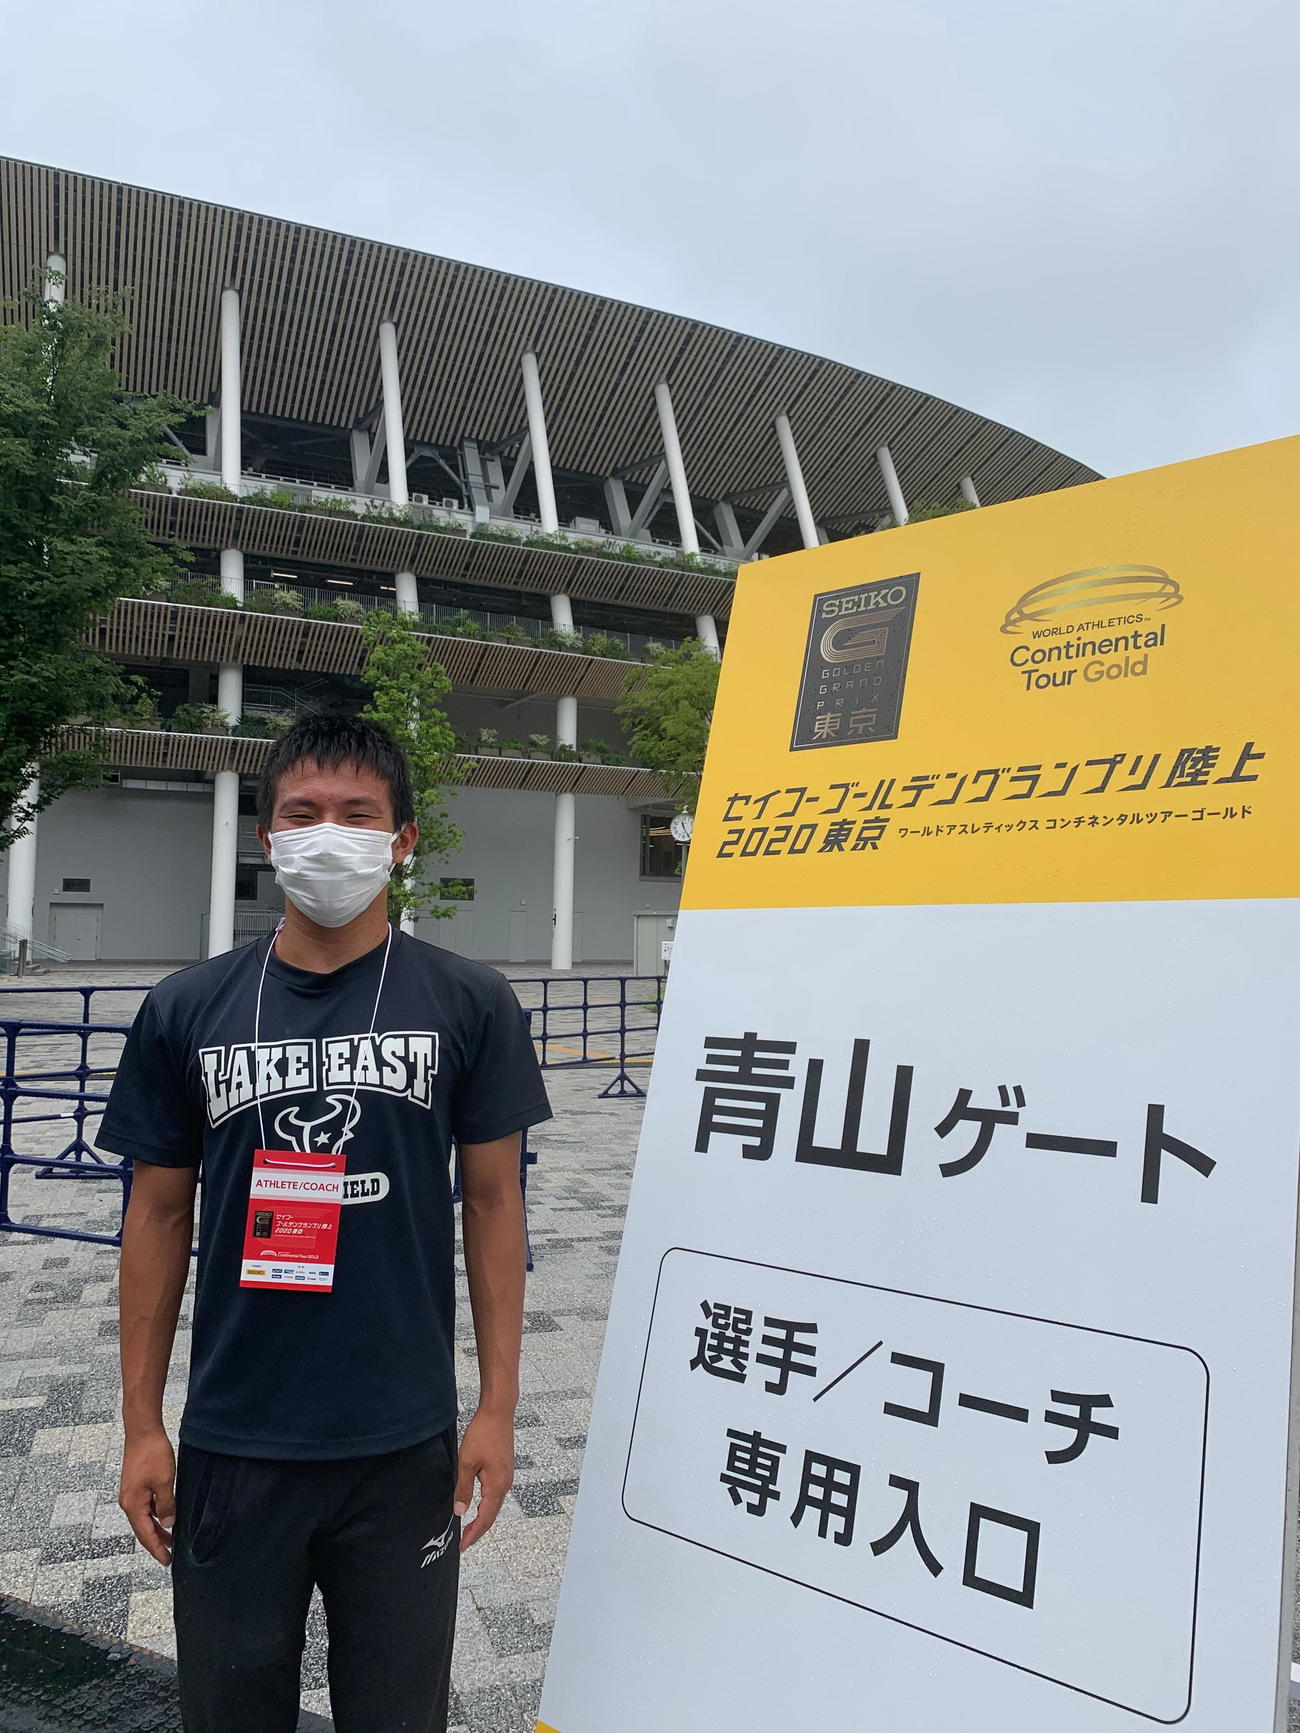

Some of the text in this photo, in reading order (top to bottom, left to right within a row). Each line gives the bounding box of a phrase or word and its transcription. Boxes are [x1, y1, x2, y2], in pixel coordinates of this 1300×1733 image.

[822, 586, 906, 618] SEIKO
[1009, 623, 1166, 668] Continental
[1032, 624, 1075, 640] WORLD
[819, 676, 882, 695] GRAND
[822, 660, 885, 679] GOLDEN
[1021, 653, 1149, 692] Tour Gold
[816, 692, 880, 710] PRIX
[812, 707, 879, 740] 東京
[201, 1033, 437, 1126] LAKE EAST
[694, 1031, 1217, 1204] 青山ゲート
[255, 1179, 339, 1192] ATHLETE/COACH
[343, 1178, 380, 1199] IELD
[719, 1428, 1041, 1610] 専用入口
